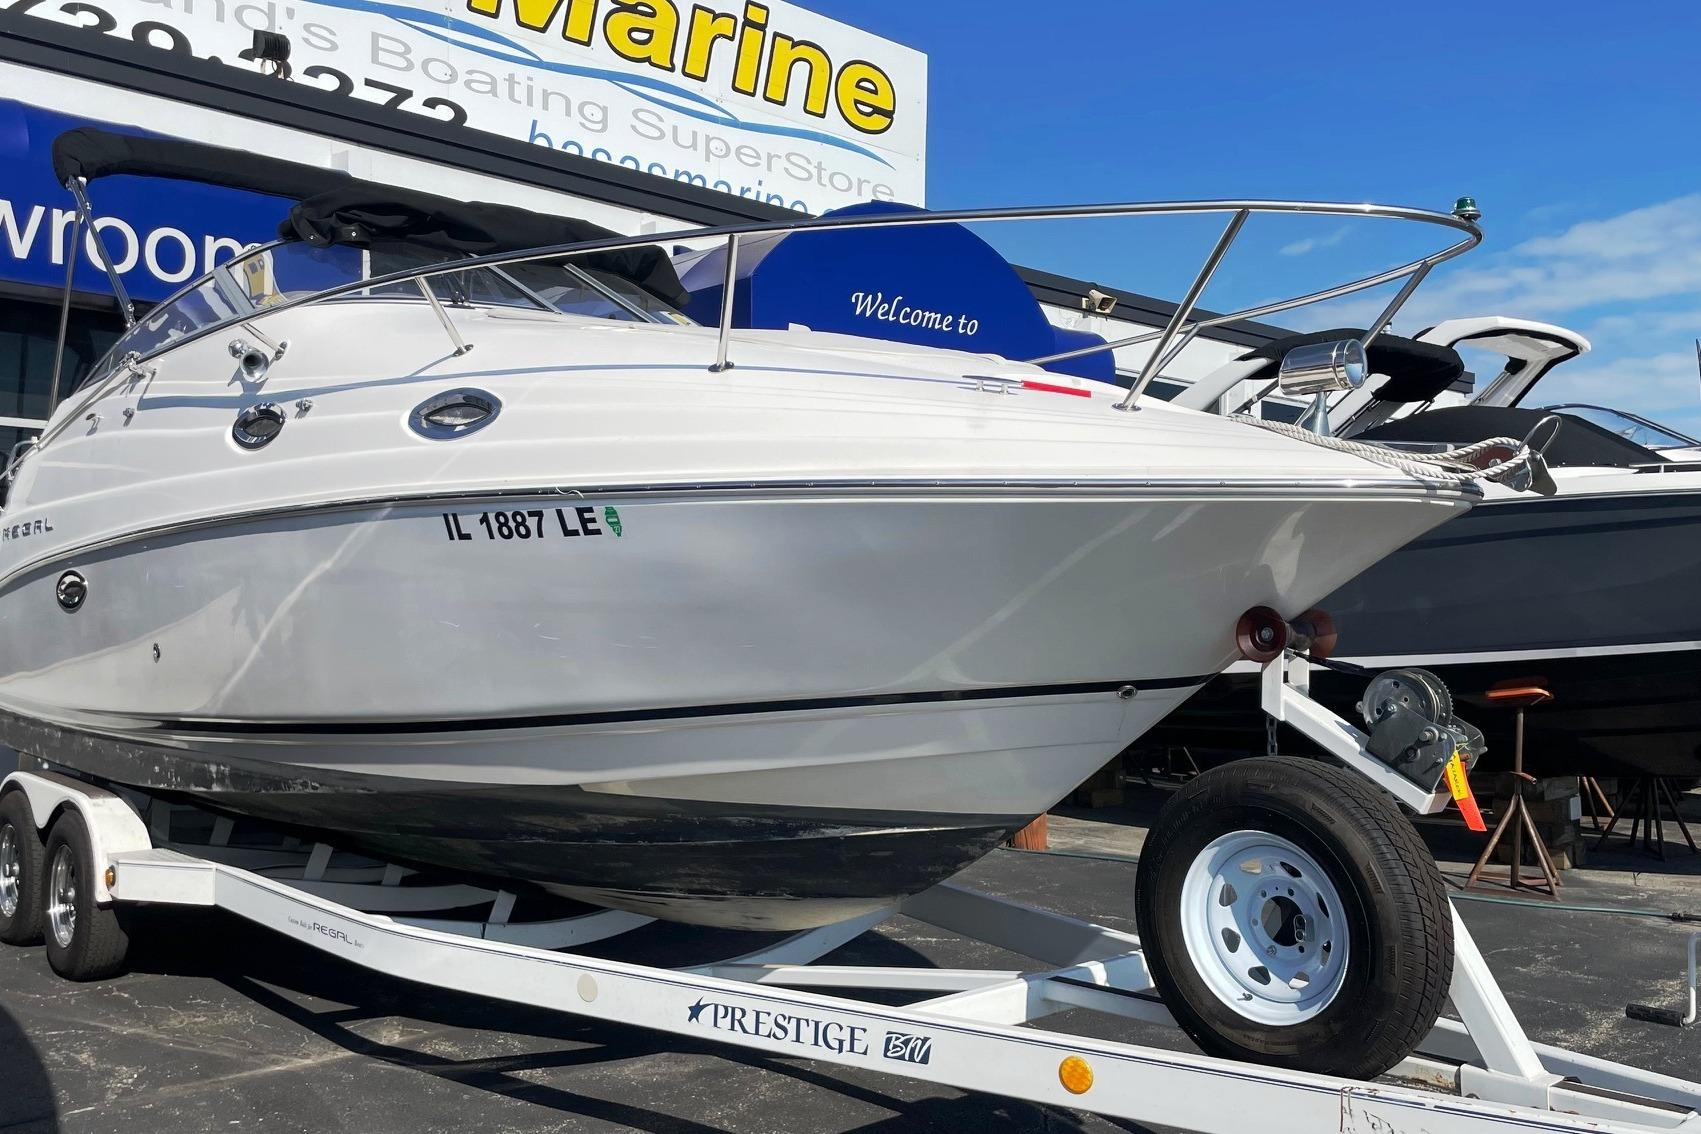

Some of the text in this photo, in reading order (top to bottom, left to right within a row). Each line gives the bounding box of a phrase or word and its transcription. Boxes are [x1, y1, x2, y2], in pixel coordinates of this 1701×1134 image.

[138, 0, 340, 52] nd's
[371, 31, 609, 133] Boating
[630, 108, 895, 202] SuperStore
[851, 291, 979, 336] Welcome to
[3, 518, 53, 541] REGAL
[443, 512, 472, 541] IL
[479, 510, 544, 540] 1887
[556, 506, 602, 537] LE
[313, 922, 352, 944] REGAL
[711, 1003, 869, 1056] PRESTIGE
